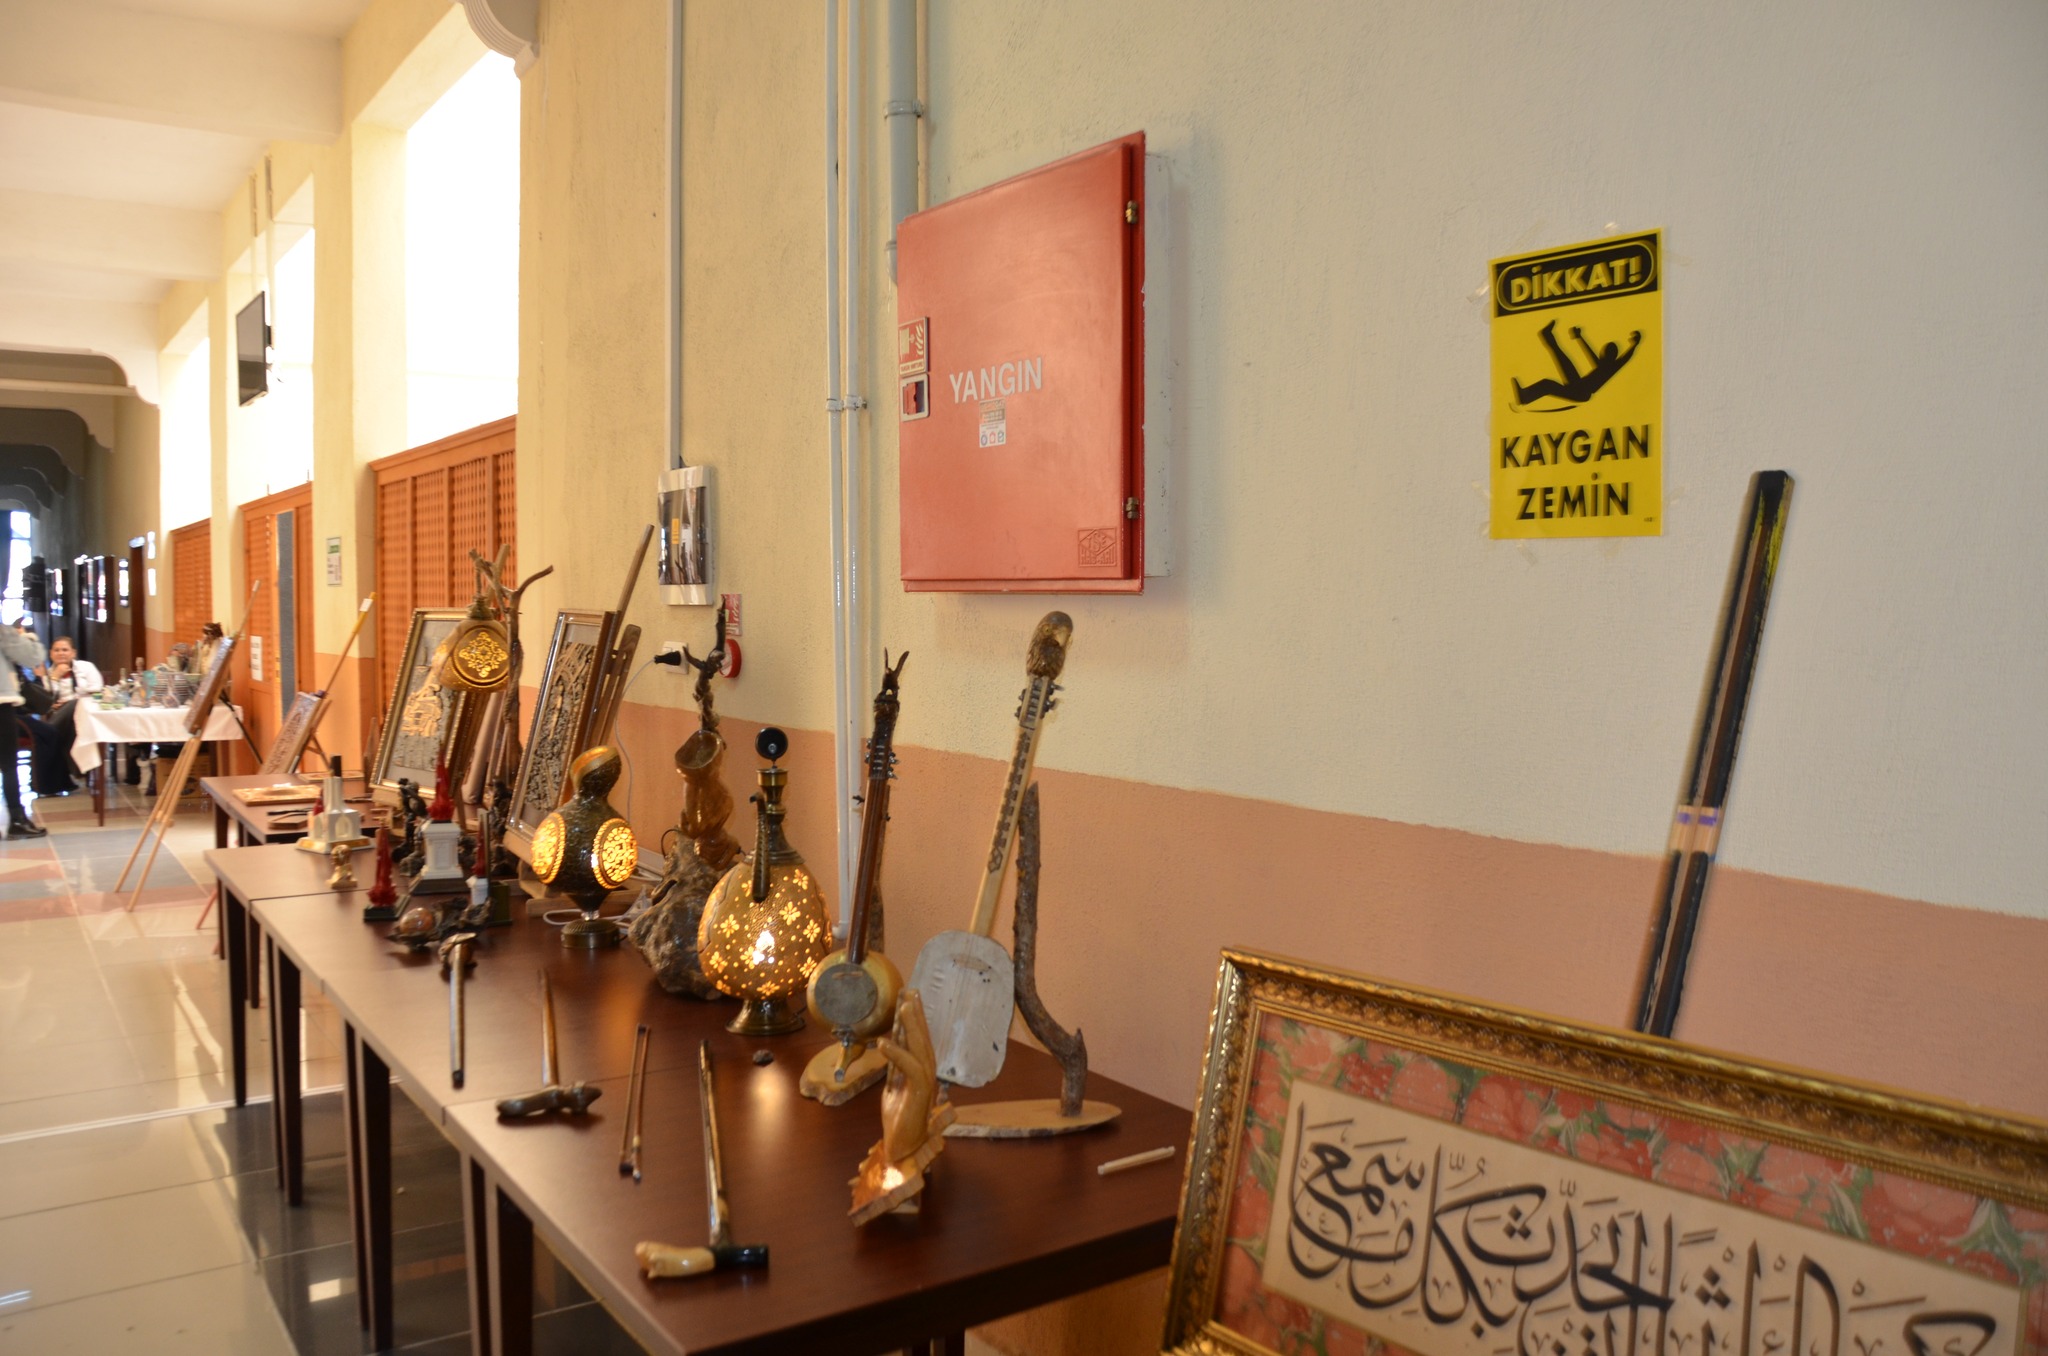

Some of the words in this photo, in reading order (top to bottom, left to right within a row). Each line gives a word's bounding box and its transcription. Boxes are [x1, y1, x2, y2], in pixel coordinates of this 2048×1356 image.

[1511, 255, 1642, 304] DİKKAT!
[949, 356, 1042, 404] YANGIN
[1500, 424, 1650, 469] KAYGAN
[1516, 472, 1630, 520] ZEMİN
